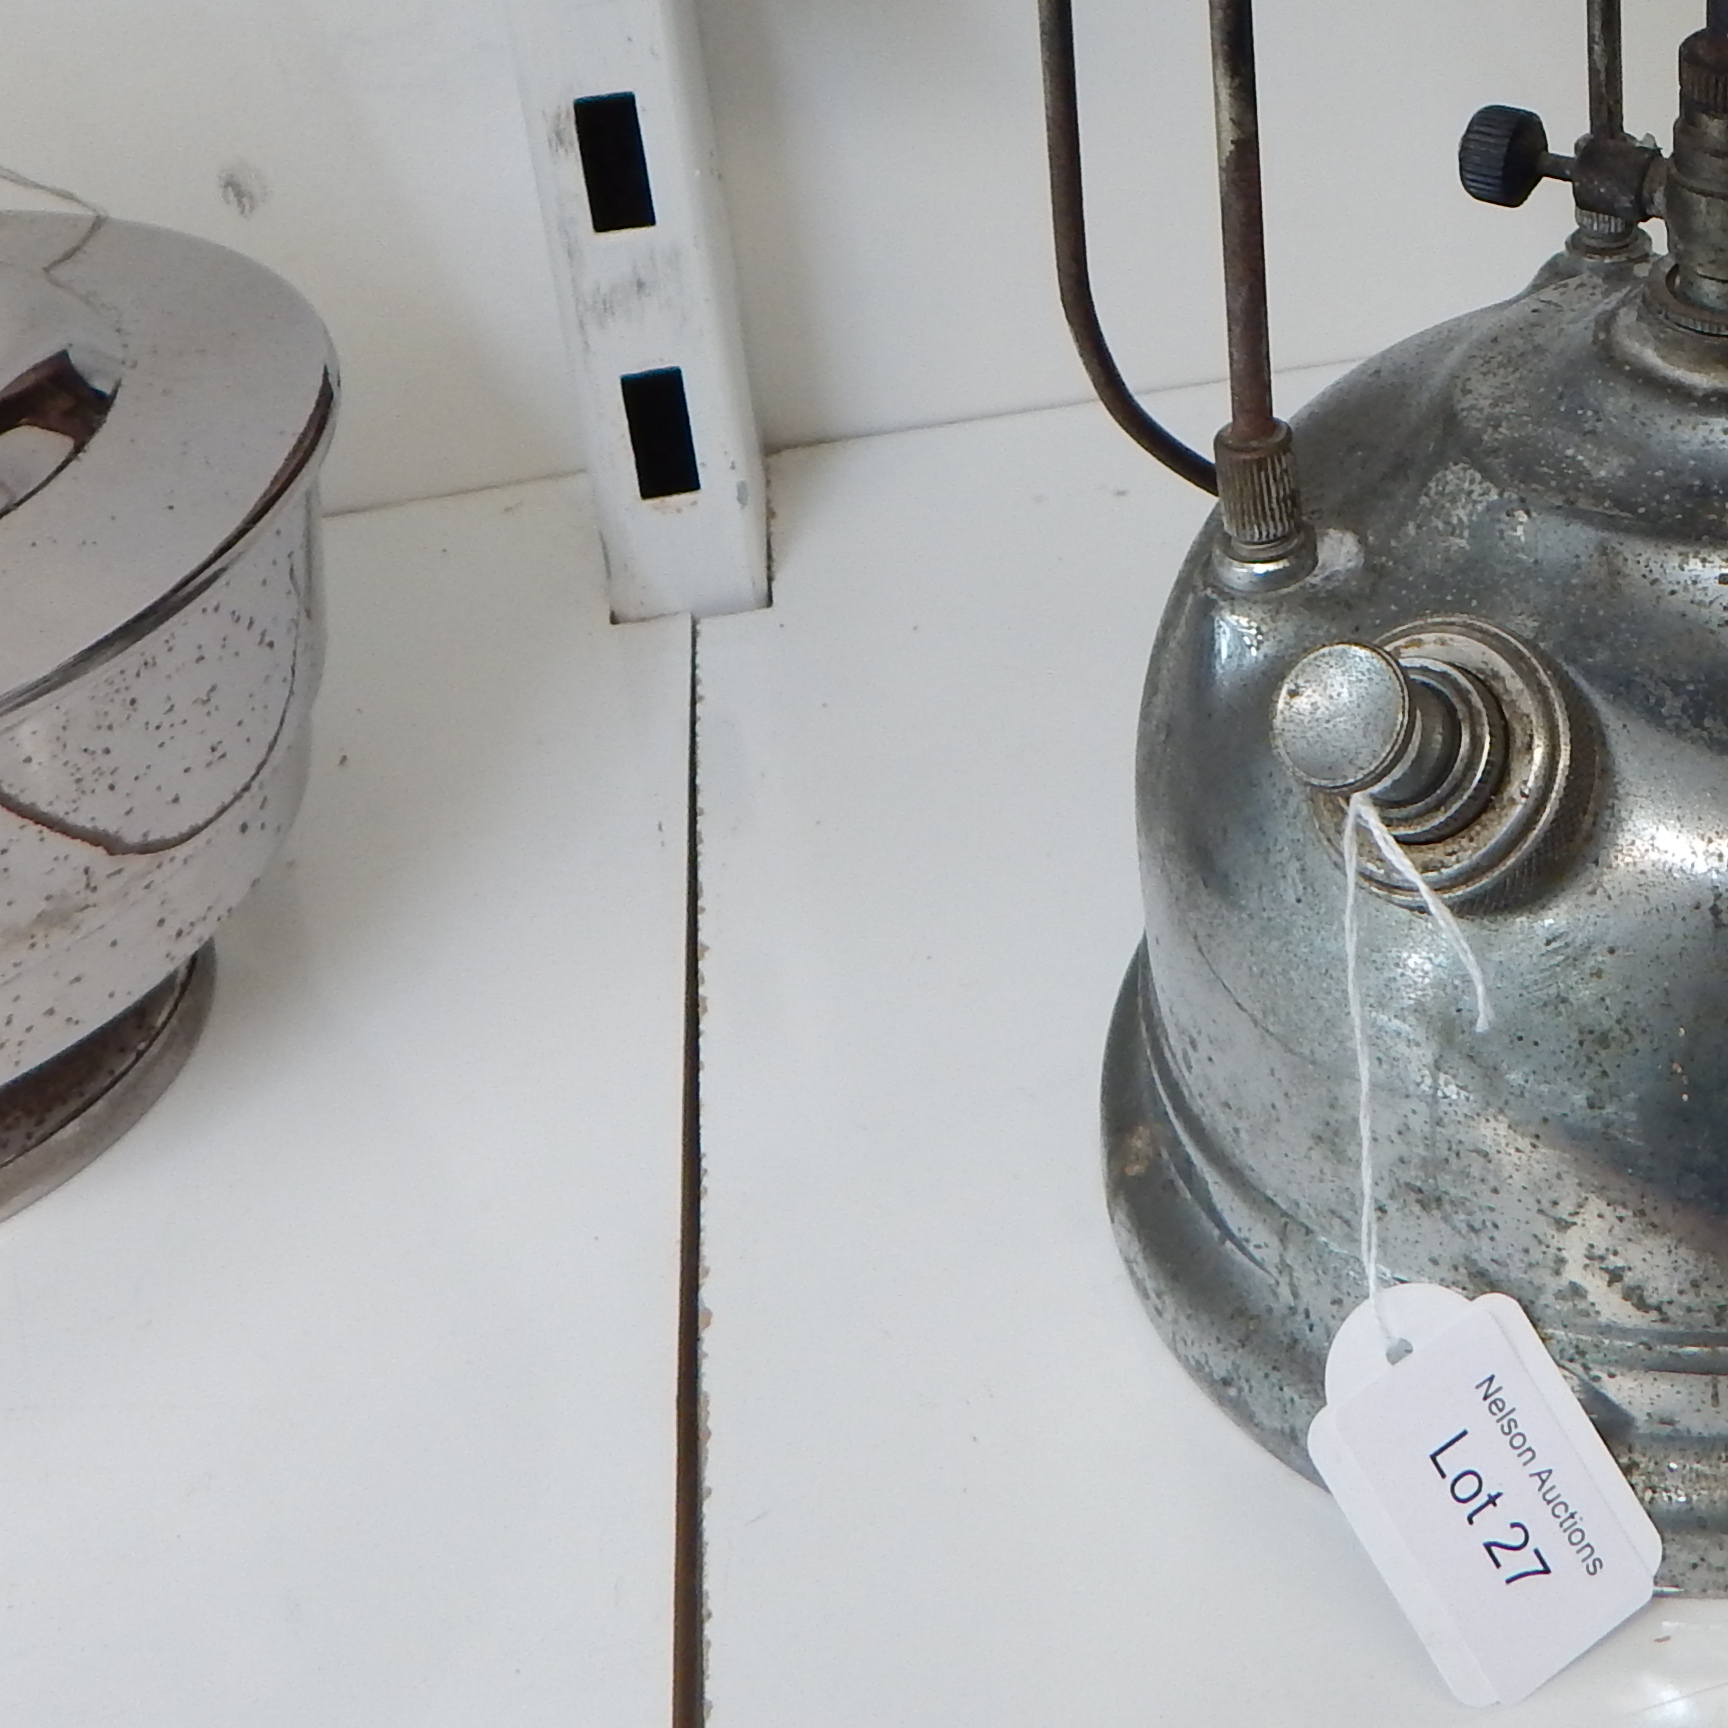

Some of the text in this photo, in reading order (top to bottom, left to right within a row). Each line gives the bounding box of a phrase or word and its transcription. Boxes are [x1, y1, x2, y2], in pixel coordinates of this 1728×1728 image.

[1428, 1428, 1553, 1586] Lot 27
[1474, 1373, 1604, 1577] Nelson Auctions
